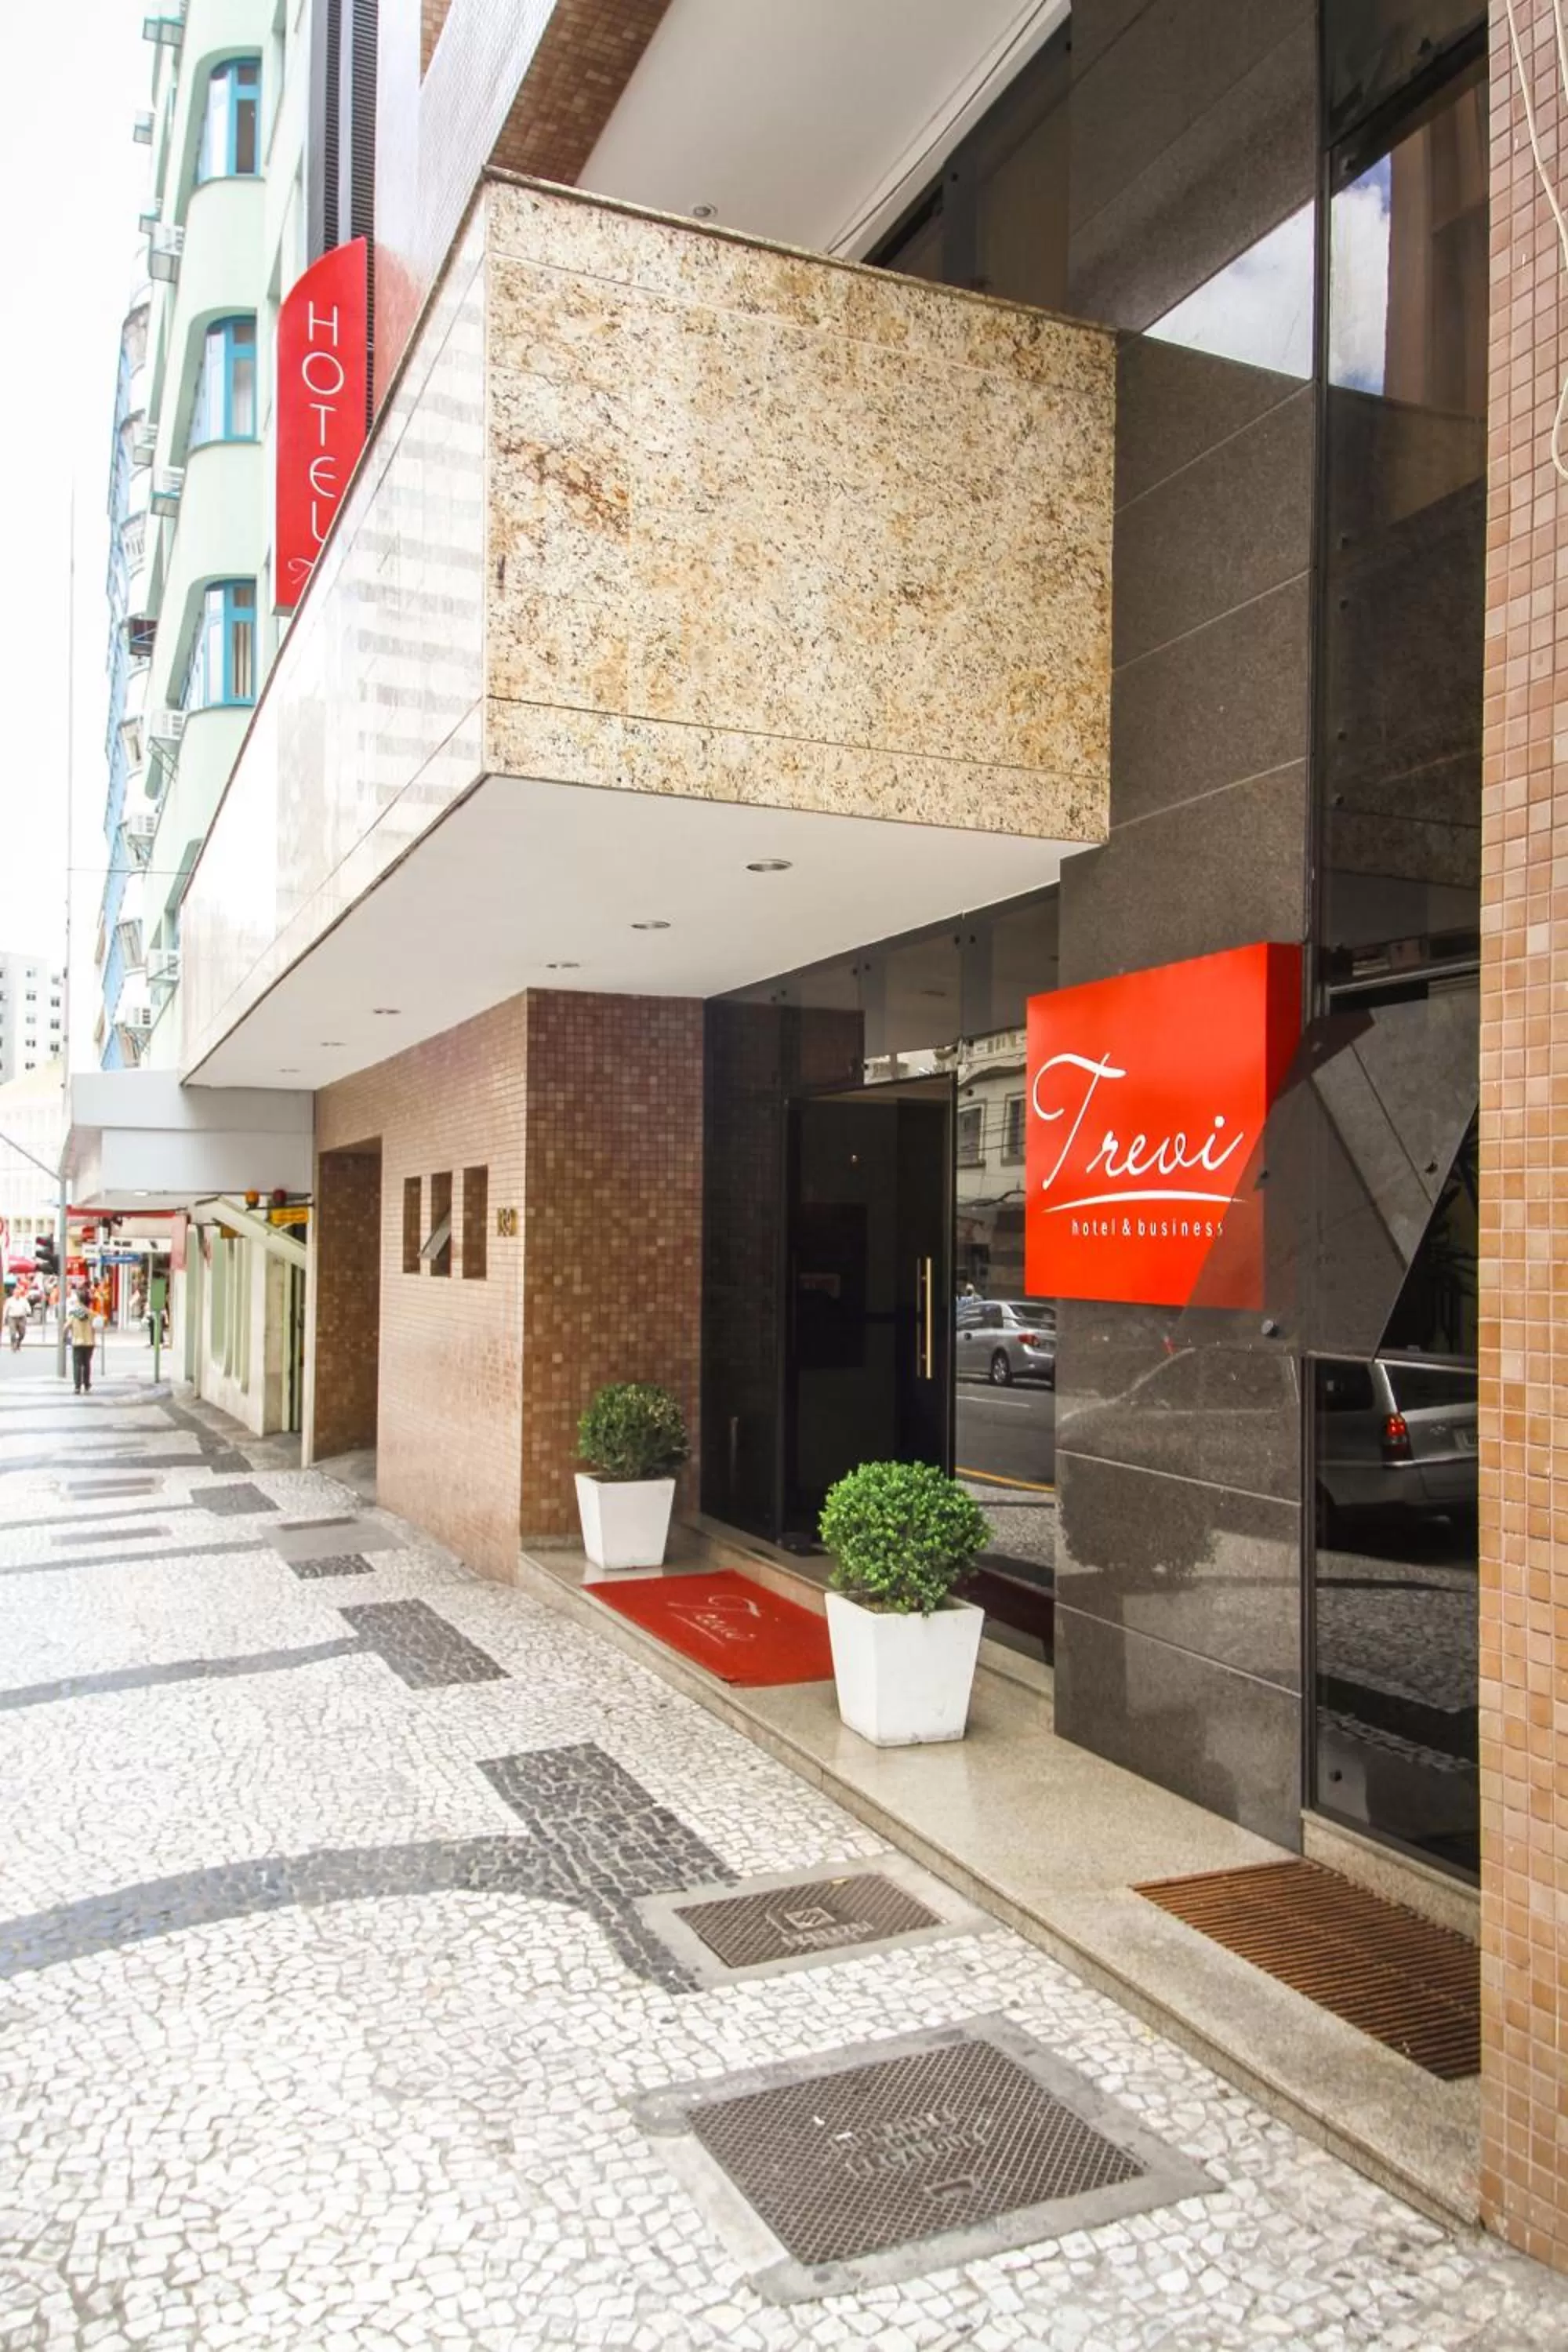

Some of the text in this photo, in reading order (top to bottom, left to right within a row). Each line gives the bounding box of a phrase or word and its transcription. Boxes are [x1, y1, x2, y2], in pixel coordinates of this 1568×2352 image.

[302, 301, 344, 541] HOTEL
[1033, 1053, 1243, 1190] Trevi
[1071, 1218, 1223, 1236] hotel & business
